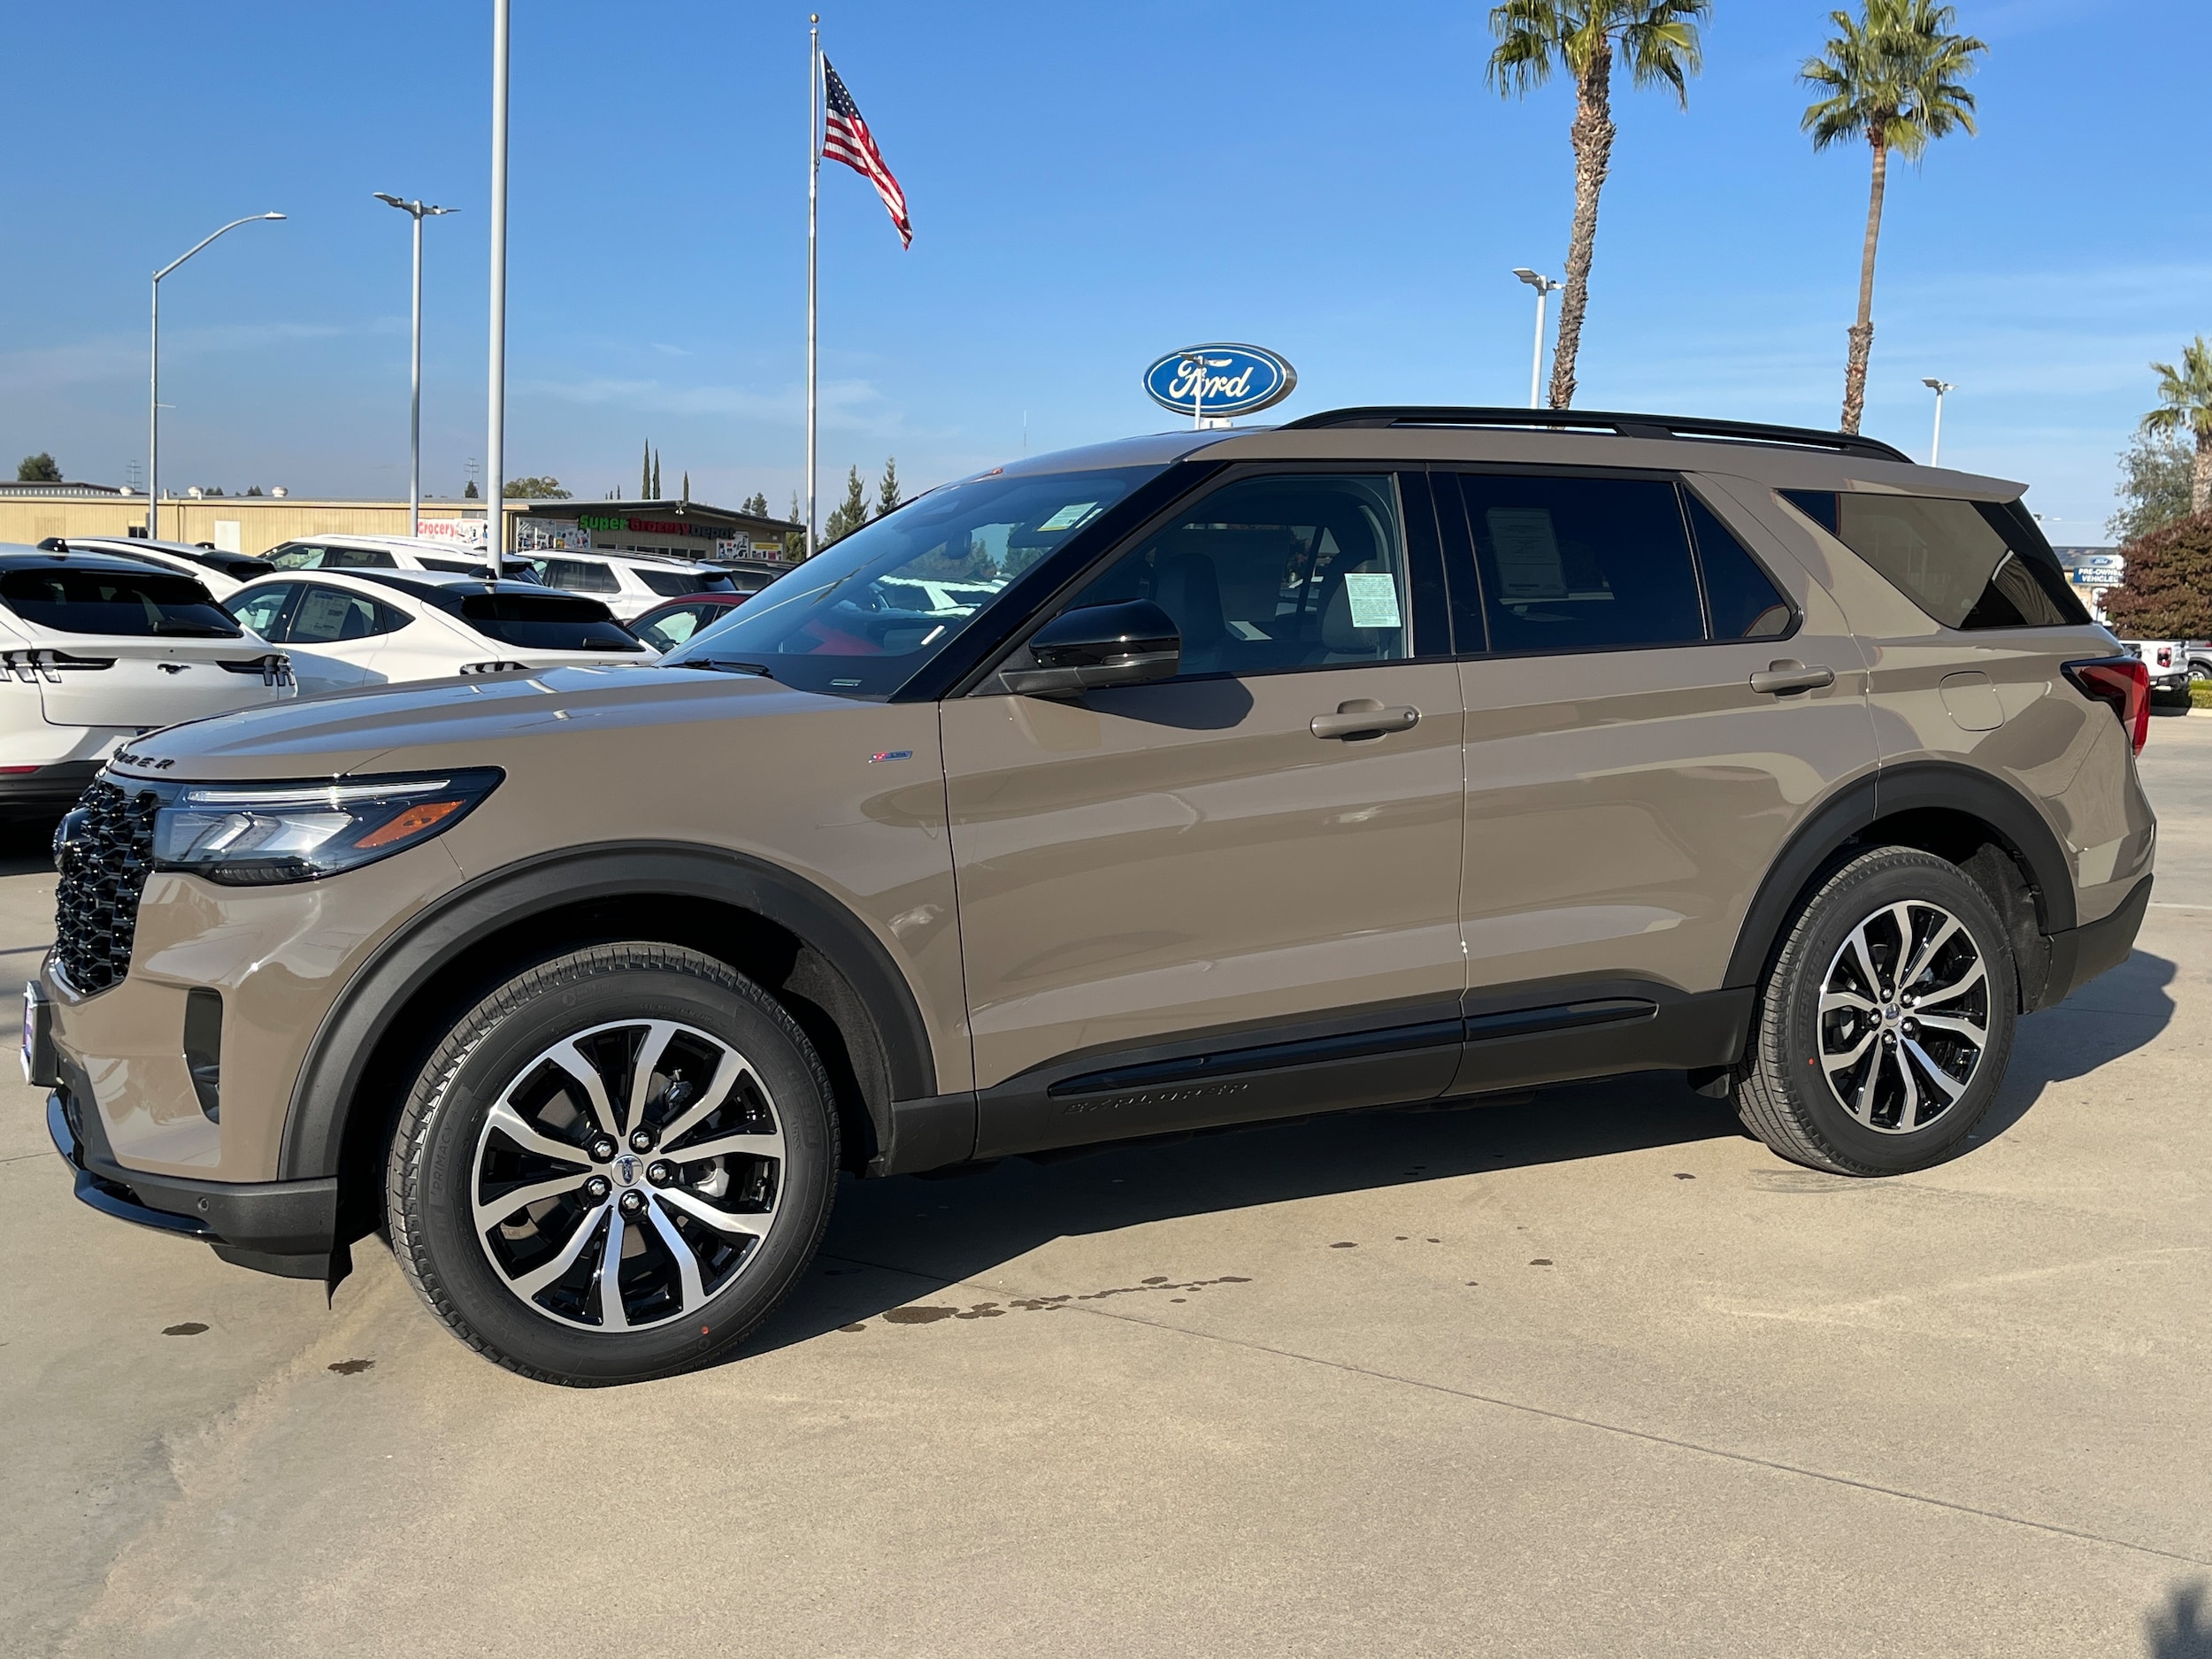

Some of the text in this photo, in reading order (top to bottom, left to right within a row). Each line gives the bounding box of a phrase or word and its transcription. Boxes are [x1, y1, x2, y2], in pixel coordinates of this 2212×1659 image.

[1169, 357, 1255, 399] Ford
[418, 520, 454, 537] Grocery
[580, 514, 735, 540] Super Grocery Depot
